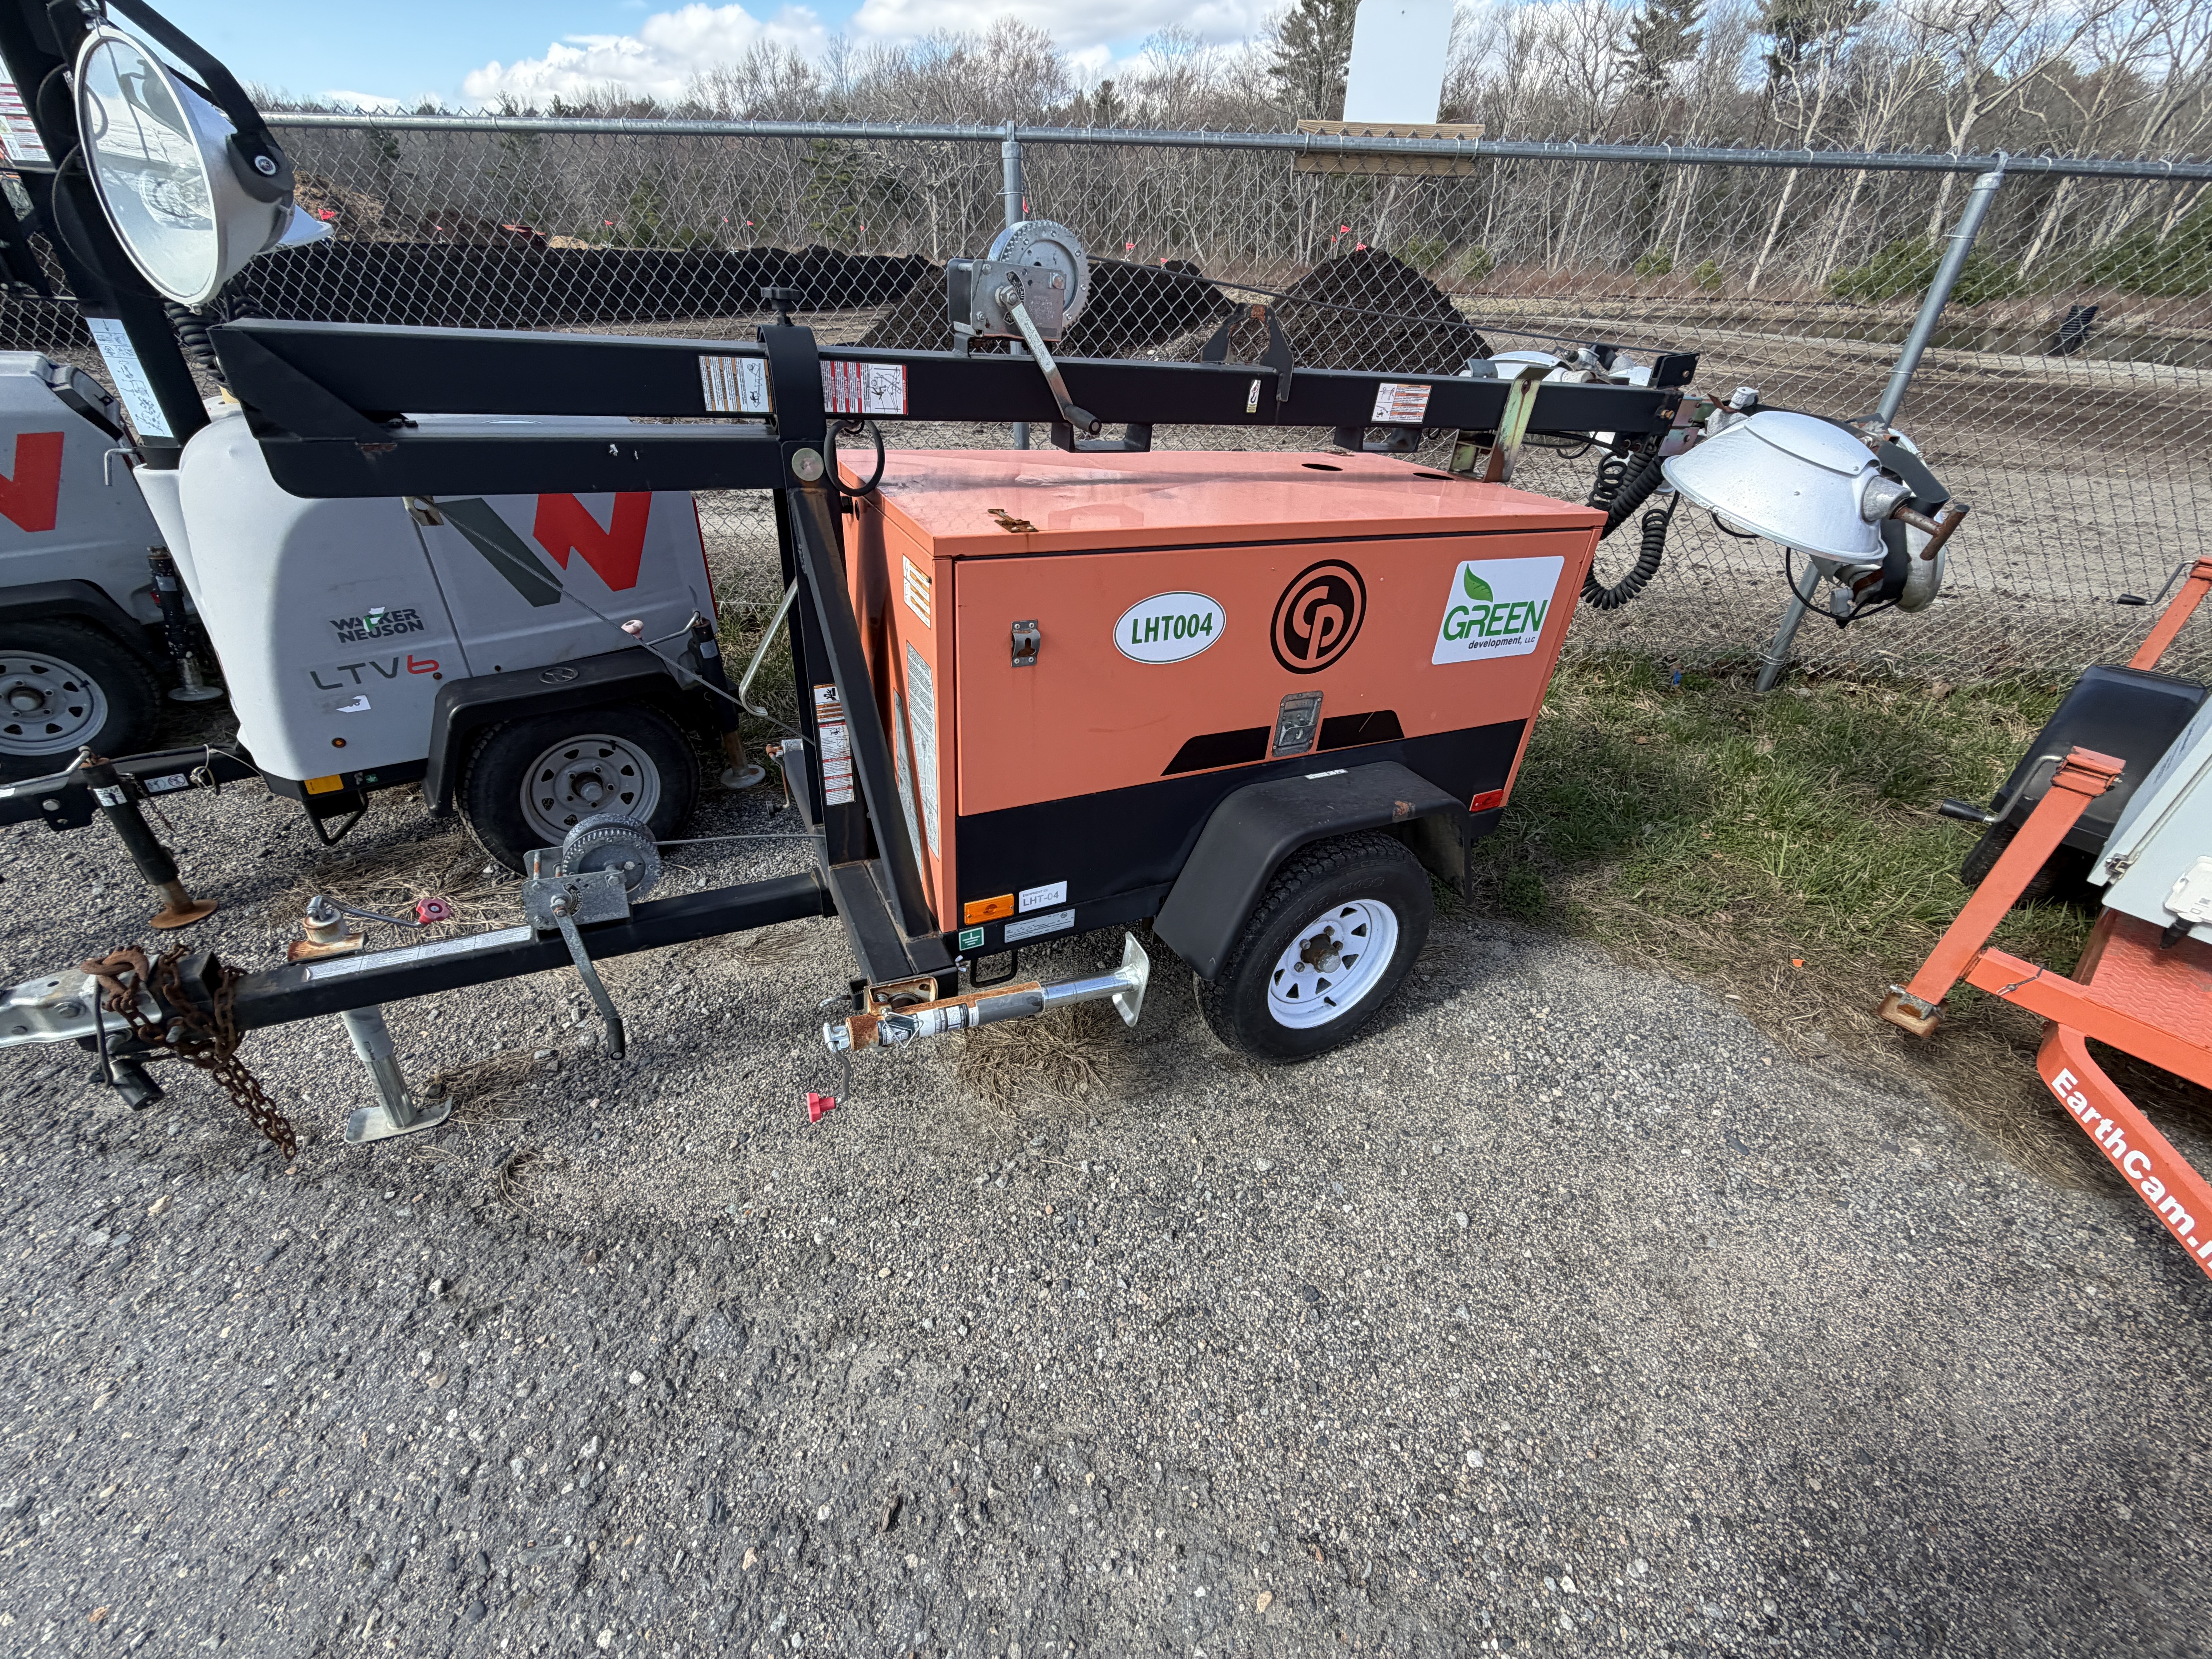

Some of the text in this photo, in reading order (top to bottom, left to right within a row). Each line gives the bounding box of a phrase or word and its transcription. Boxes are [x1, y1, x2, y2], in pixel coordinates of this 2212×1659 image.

[329, 608, 420, 630] WAKER
[1132, 612, 1212, 644] LHT004
[1443, 599, 1548, 641] GREEN
[337, 619, 424, 643] NEUSON
[1468, 635, 1522, 649] development,
[1023, 891, 1059, 907] LHT-04
